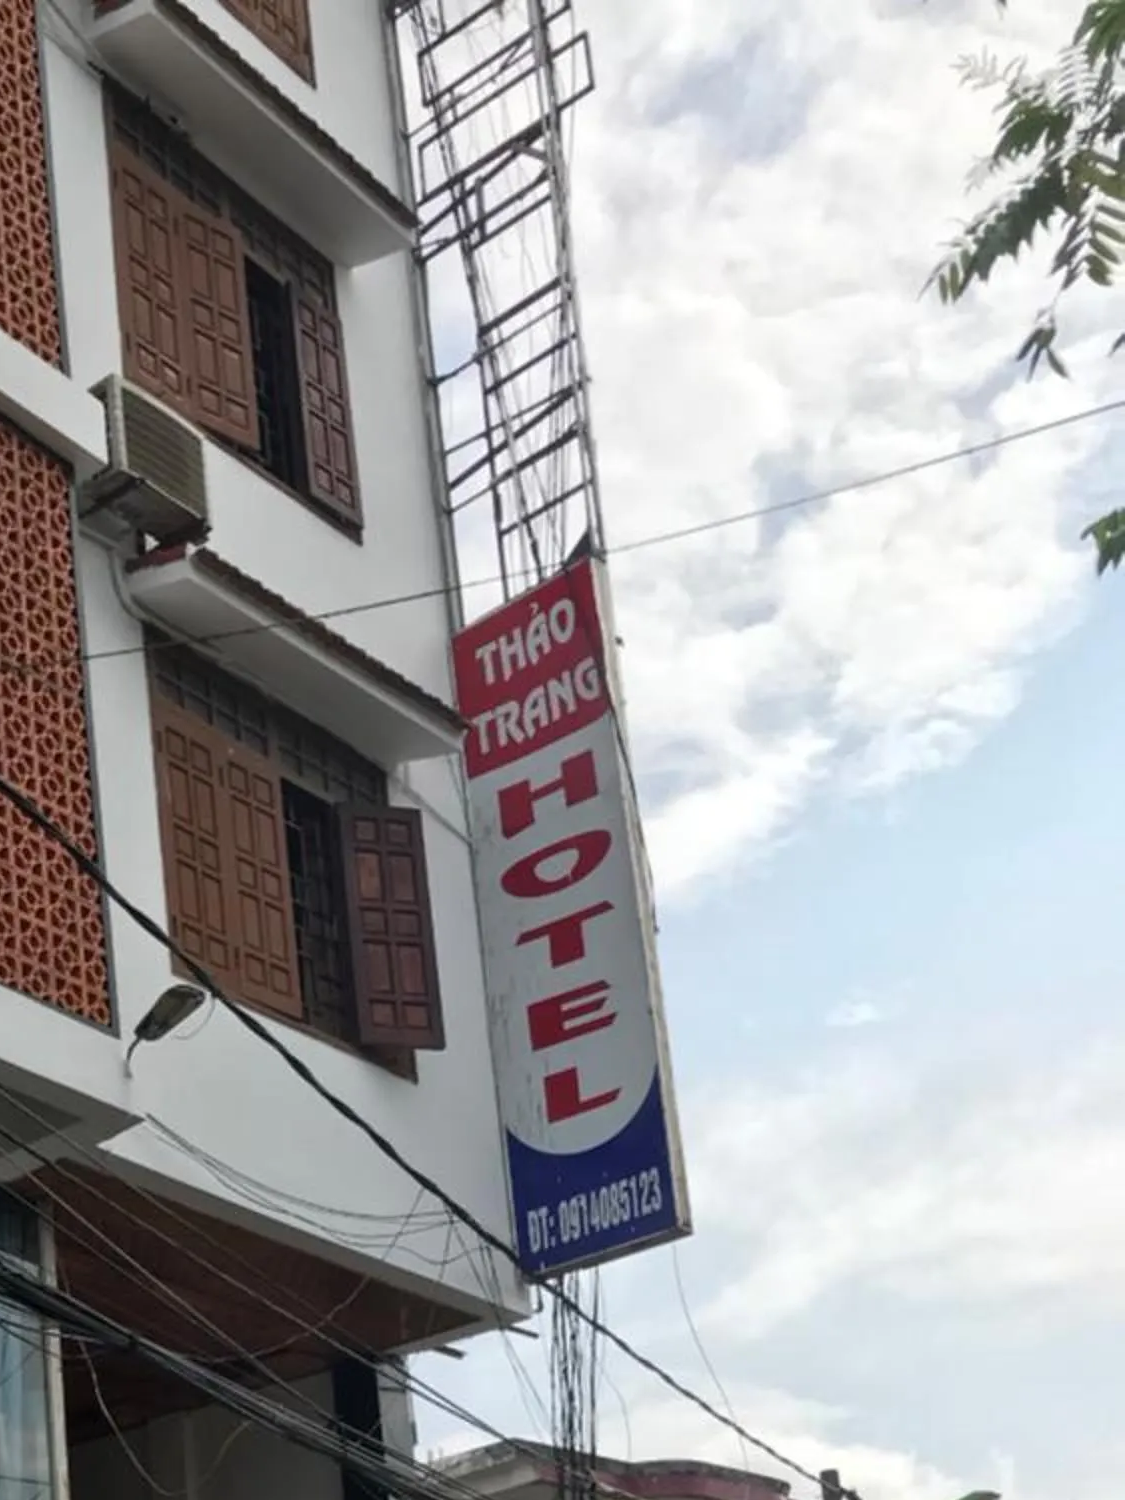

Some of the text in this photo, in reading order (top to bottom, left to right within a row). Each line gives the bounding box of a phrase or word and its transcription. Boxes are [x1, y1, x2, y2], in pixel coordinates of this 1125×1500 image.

[475, 598, 574, 686] THẢO
[471, 656, 602, 756] TRANG
[496, 749, 622, 1124] HOTEL
[559, 1167, 663, 1244] 0914085123
